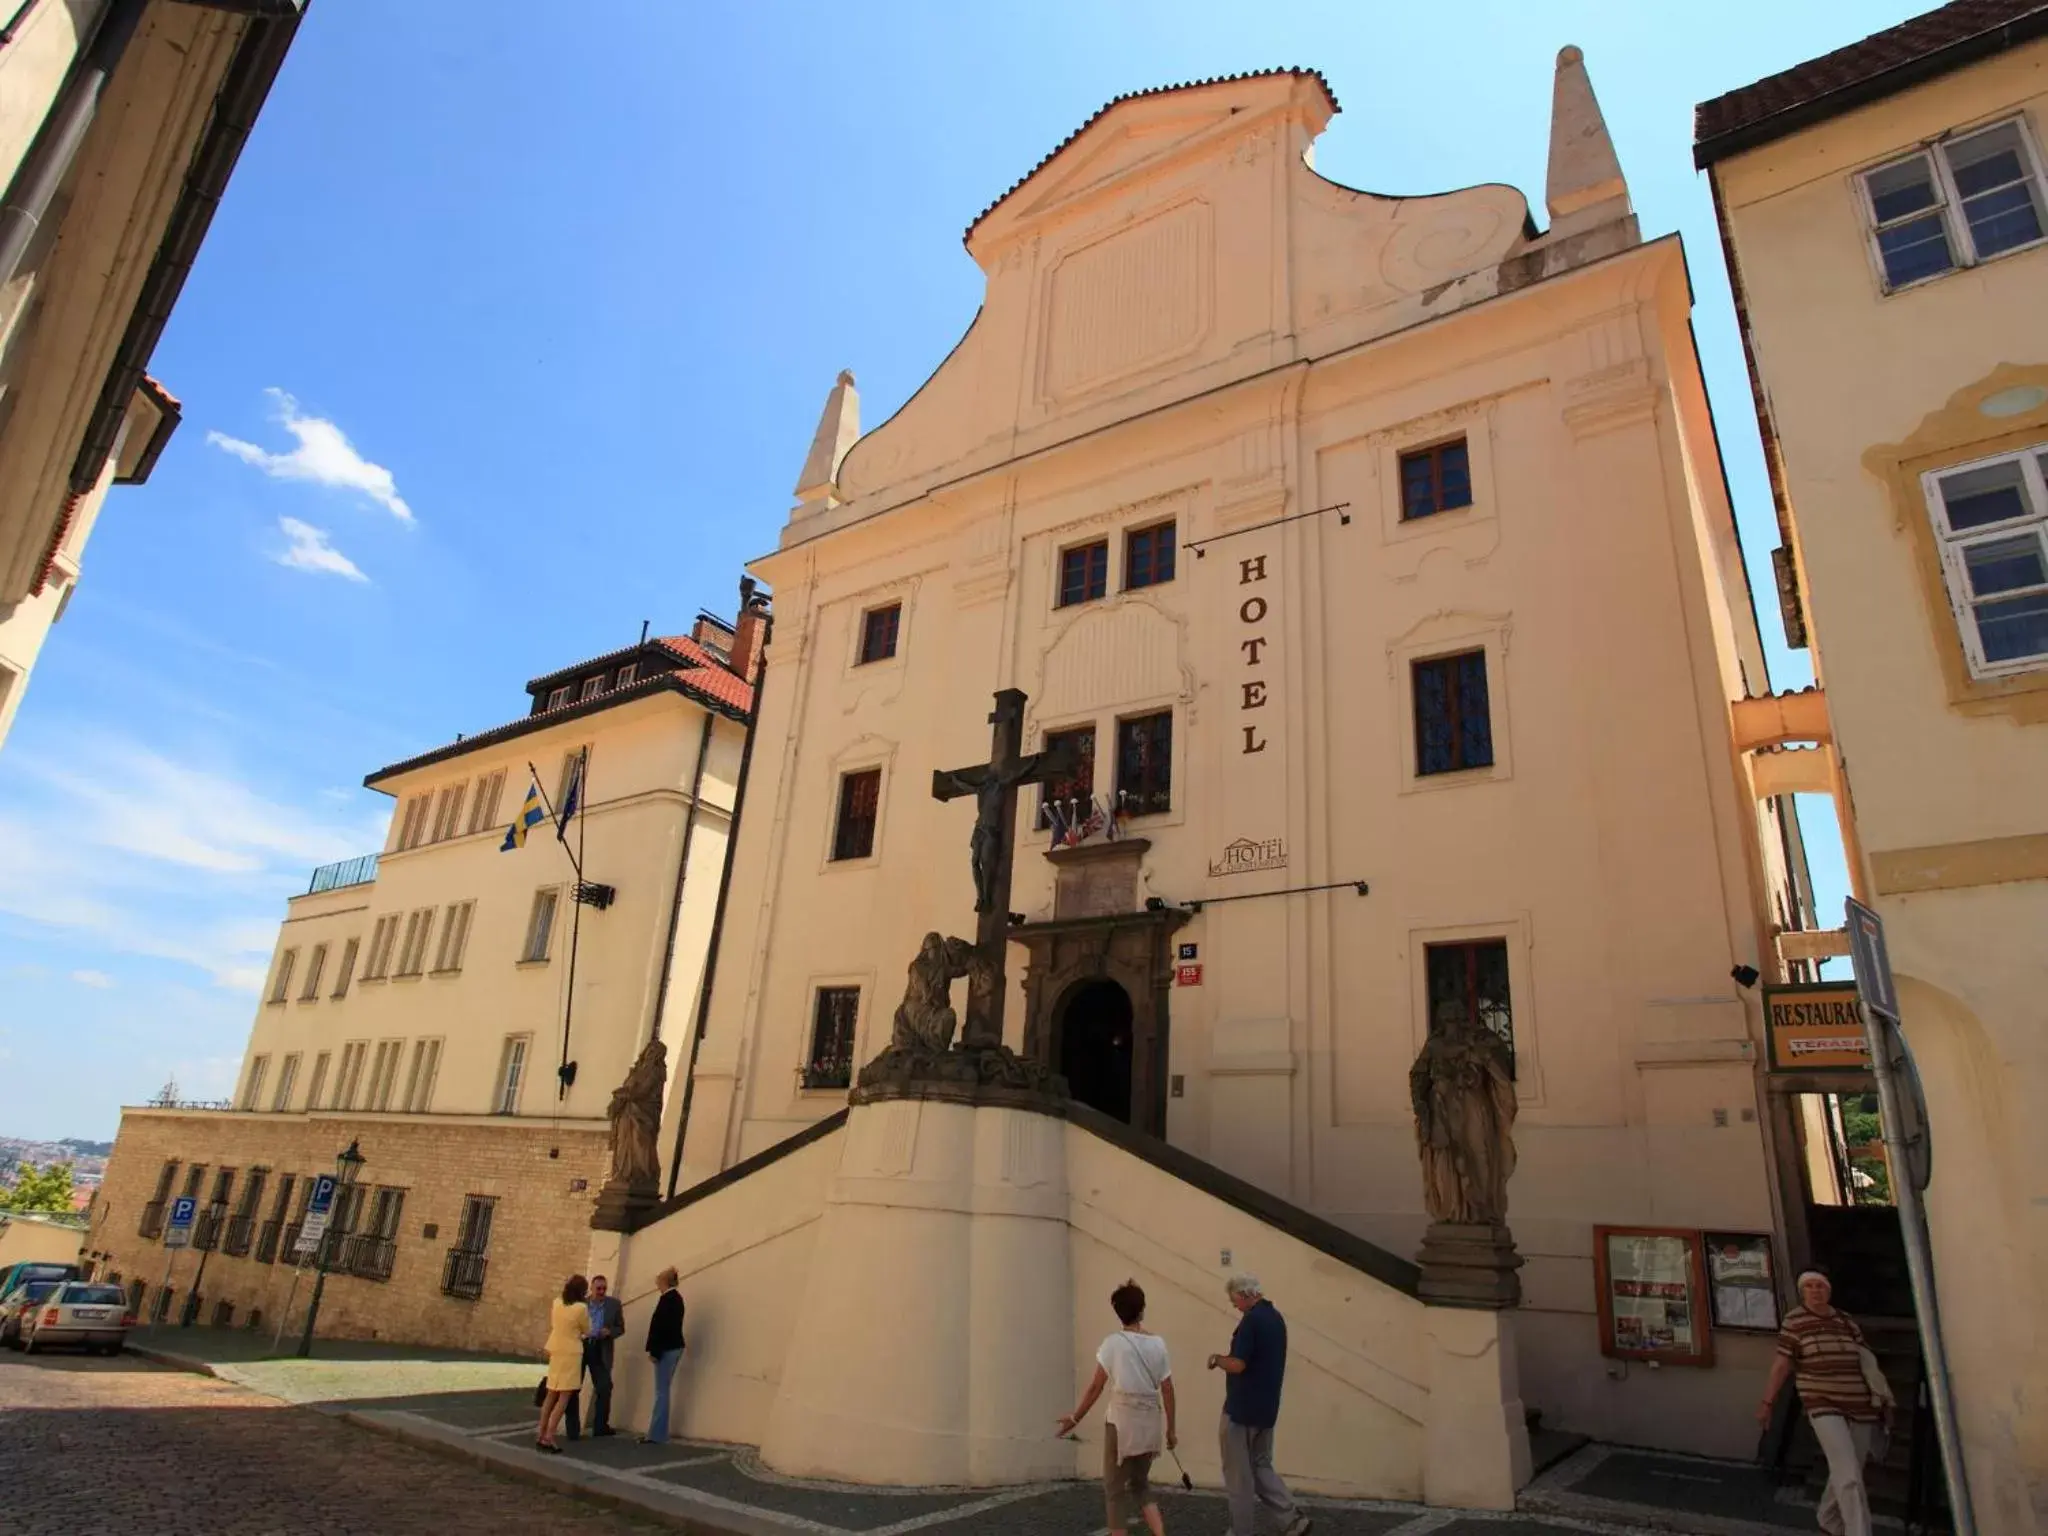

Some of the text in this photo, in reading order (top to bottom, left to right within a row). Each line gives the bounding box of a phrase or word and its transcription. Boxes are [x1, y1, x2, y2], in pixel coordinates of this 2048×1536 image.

[1239, 555, 1267, 754] HOTEL
[1227, 842, 1287, 864] HOTEL
[317, 1180, 332, 1200] P
[175, 1201, 192, 1218] P
